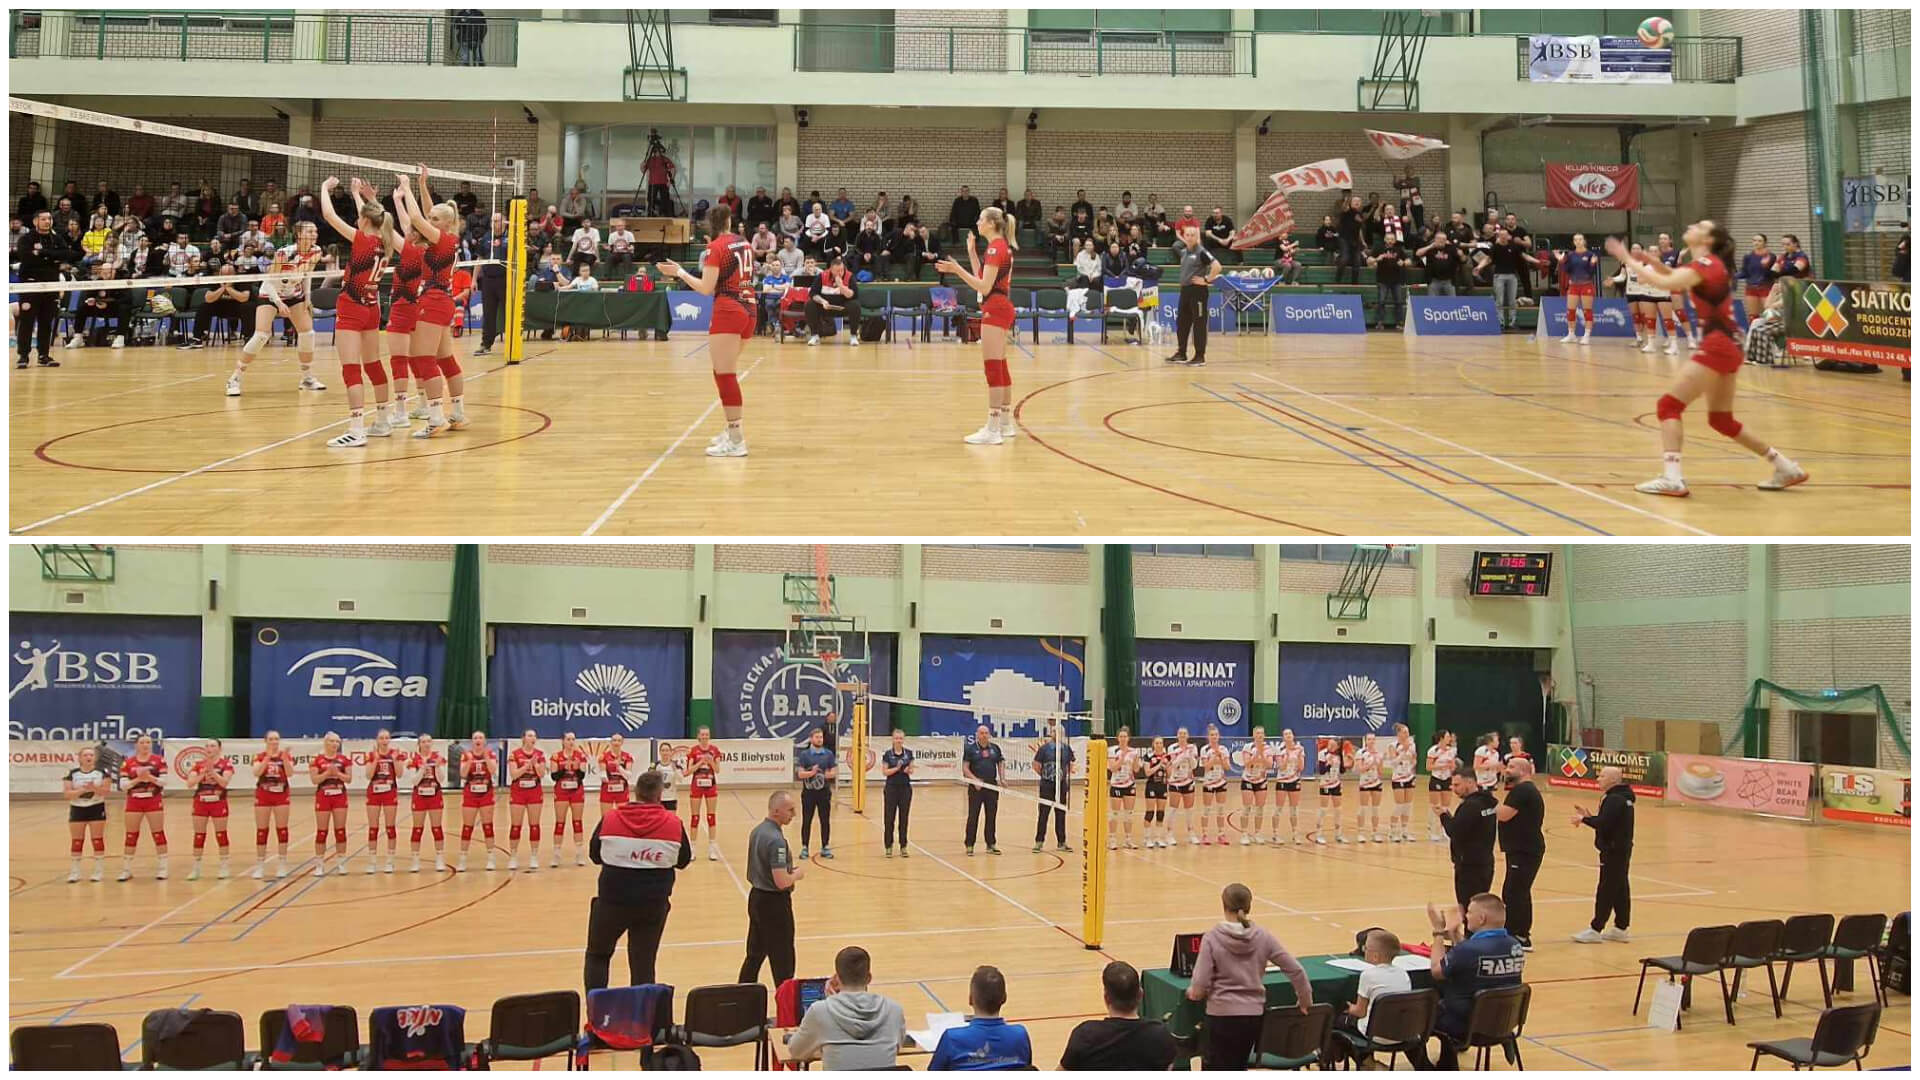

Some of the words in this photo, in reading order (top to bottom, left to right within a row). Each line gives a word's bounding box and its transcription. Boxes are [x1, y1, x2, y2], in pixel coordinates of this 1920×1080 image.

[1550, 43, 1592, 59] BSB
[1860, 184, 1901, 203] BSB
[734, 248, 753, 279] 14
[55, 652, 159, 683] BSB
[1141, 661, 1237, 678] KOMBINAT
[309, 667, 428, 698] Enea
[1141, 680, 1181, 688] MIESZKANIA
[1186, 680, 1235, 688] APARTAMENTY
[530, 697, 612, 720] Białystok
[1303, 703, 1361, 722] Białystok
[9, 753, 81, 763] OMBINA
[741, 752, 785, 763] Białystok
[1590, 751, 1651, 767] SIATKOMET
[1777, 779, 1801, 788] WHITE
[1776, 788, 1797, 796] BEAR
[1775, 797, 1806, 807] COFFEE
[631, 848, 664, 861] NIKE
